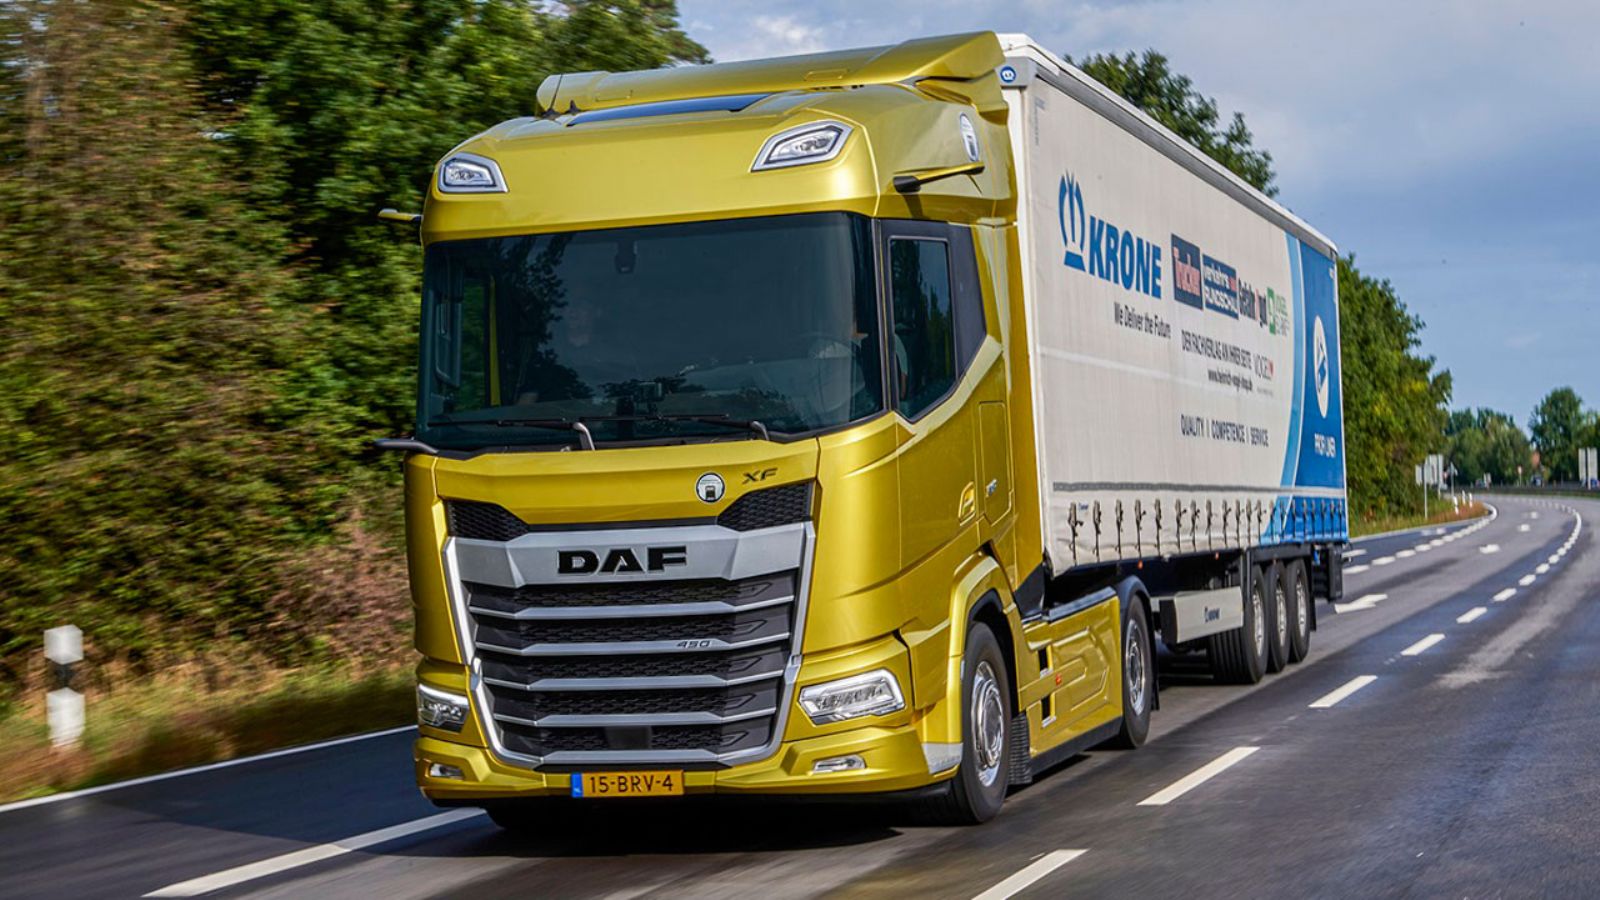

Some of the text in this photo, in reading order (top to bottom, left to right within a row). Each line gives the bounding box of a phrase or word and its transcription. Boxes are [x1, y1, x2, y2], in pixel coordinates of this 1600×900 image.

[1089, 215, 1162, 300] KRONE
[1114, 301, 1171, 340] We Deliver the Future
[1181, 414, 1204, 437] QUALITY
[1211, 419, 1245, 443] COMPETENCE
[1250, 426, 1269, 447] SERVICE
[742, 467, 778, 485] XF
[558, 546, 687, 574] DAF
[677, 640, 711, 648] 450
[589, 774, 673, 793] 15-BRV-4
